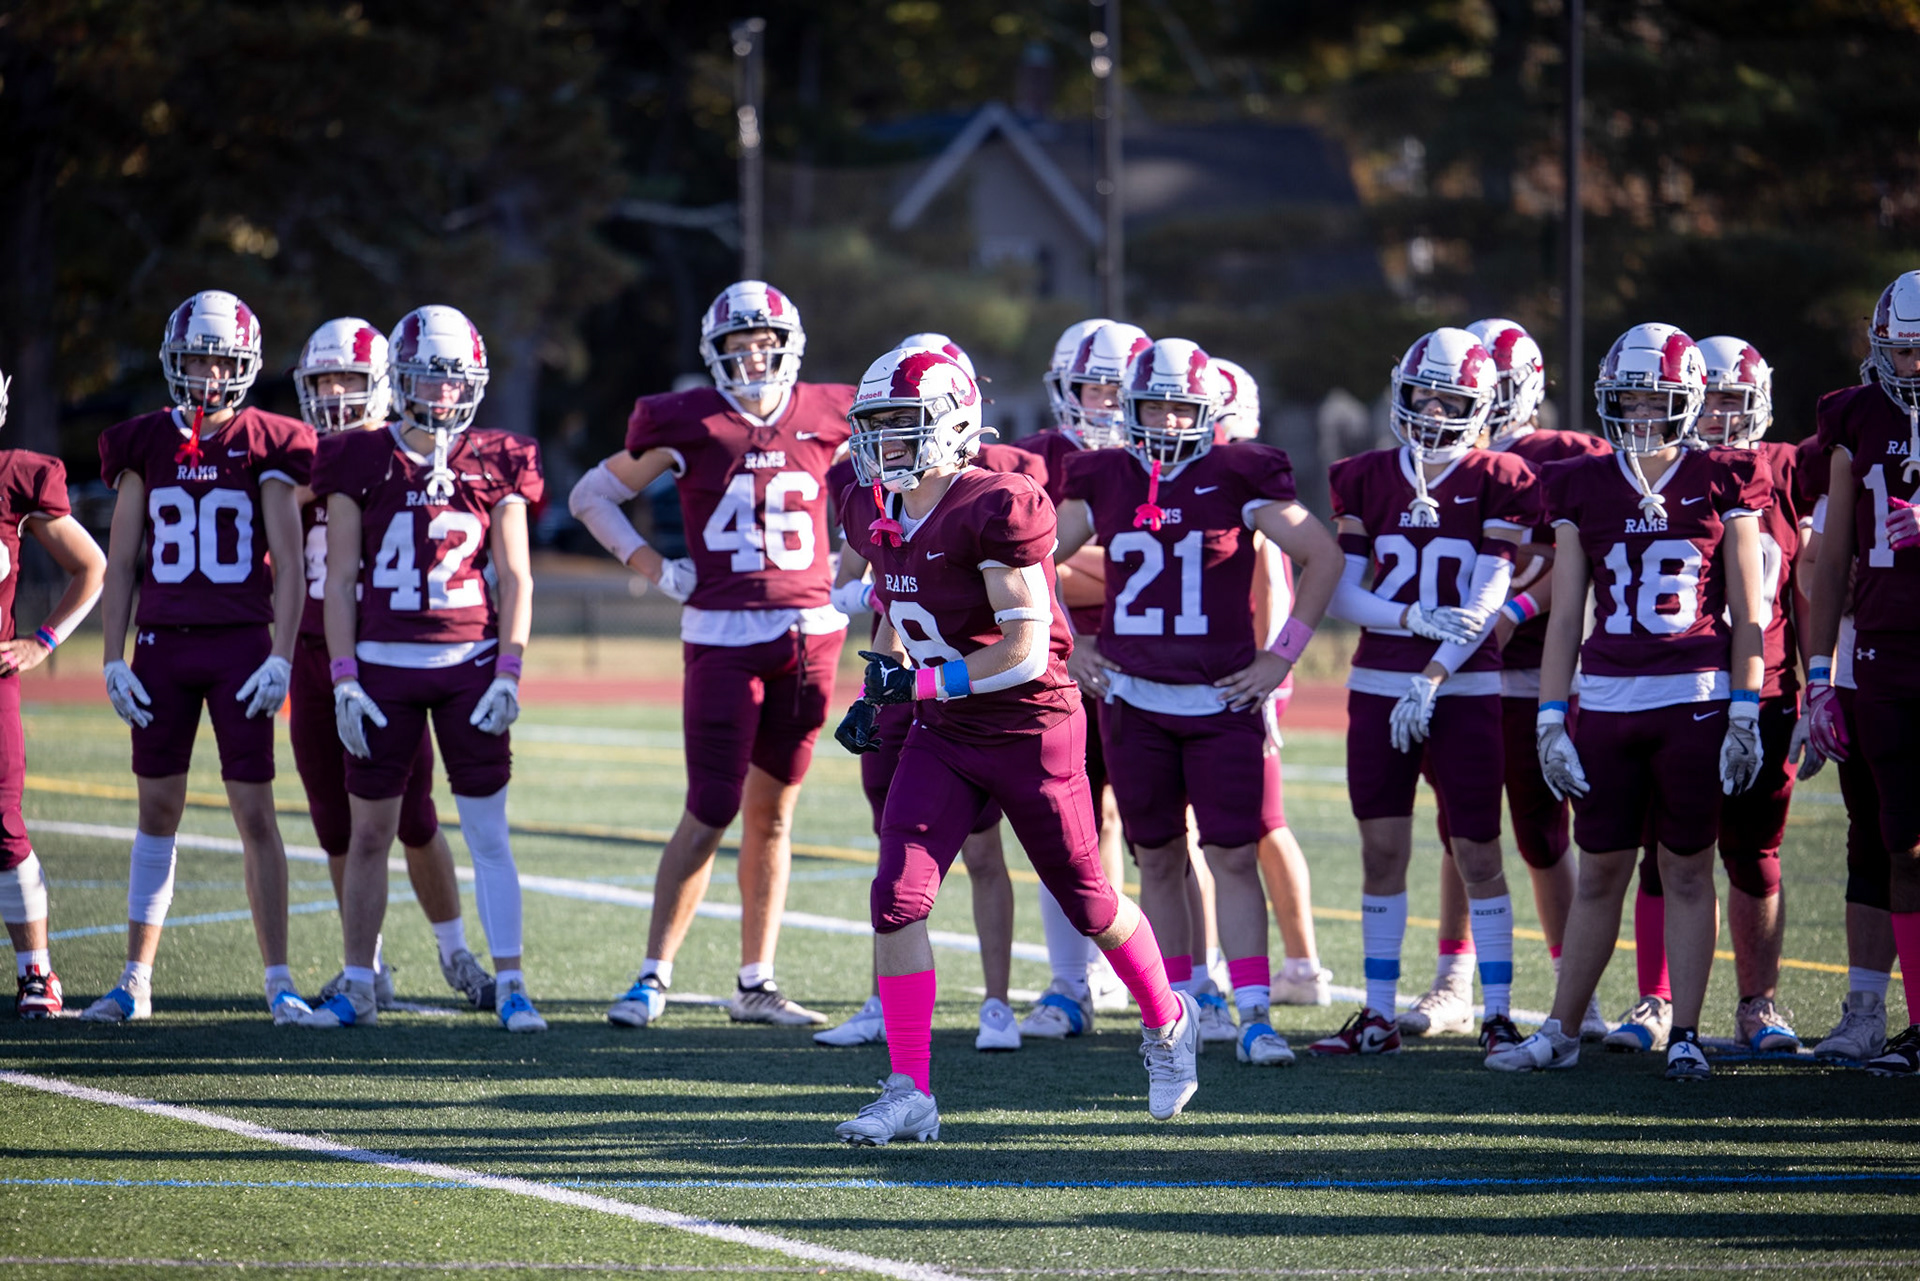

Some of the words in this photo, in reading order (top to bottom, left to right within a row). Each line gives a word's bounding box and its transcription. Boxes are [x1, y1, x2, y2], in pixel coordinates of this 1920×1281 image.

[176, 465, 218, 481] RAMS
[744, 451, 786, 469] RAMS
[149, 485, 253, 584] 80
[373, 511, 483, 611] 42
[703, 471, 819, 573] 46
[1624, 518, 1668, 533] RAMS
[885, 574, 918, 592] RAMS
[1109, 531, 1208, 635] 21
[1367, 534, 1477, 637] 20
[1603, 539, 1702, 635] 18
